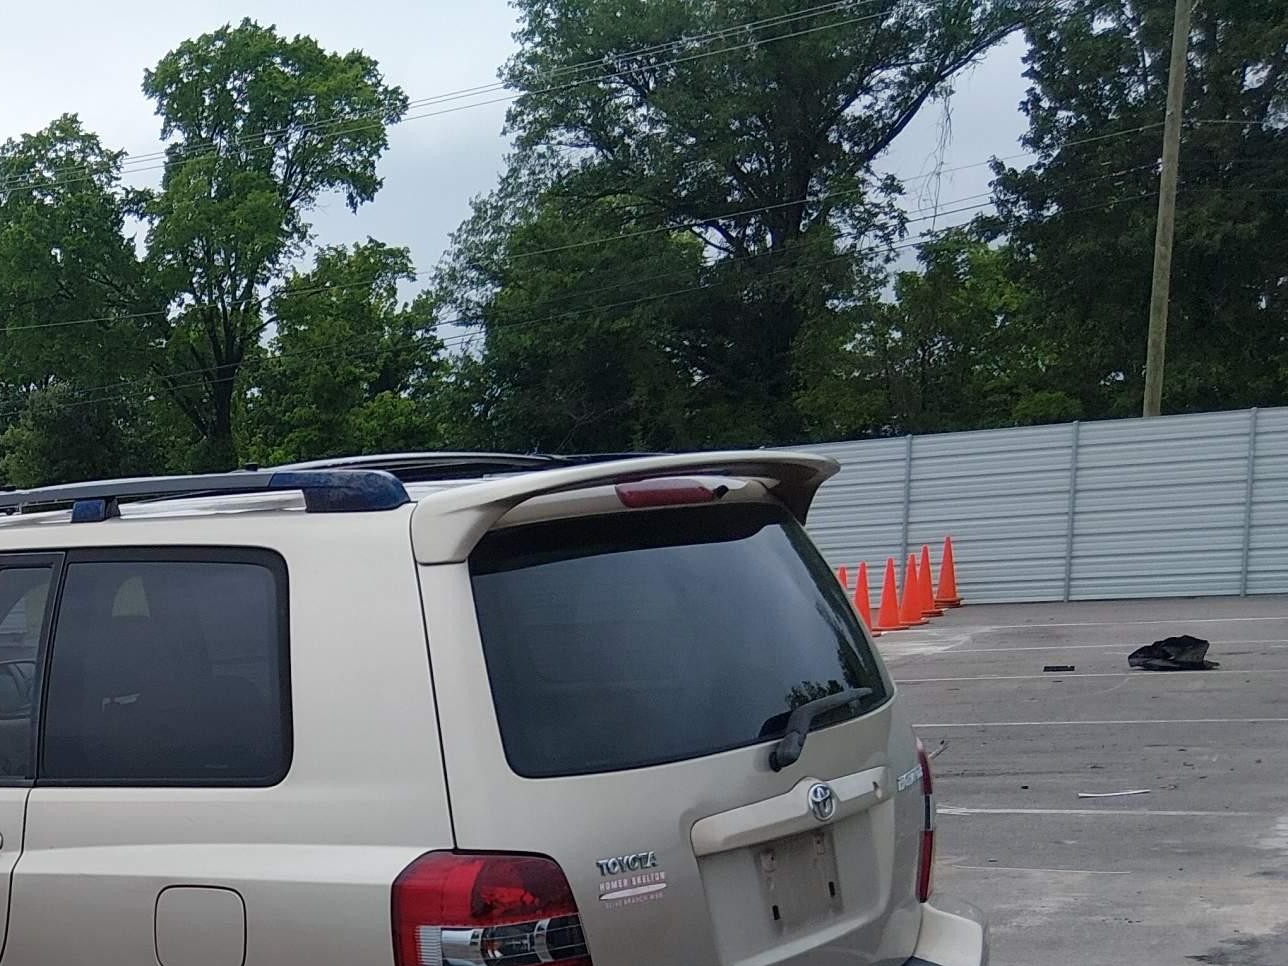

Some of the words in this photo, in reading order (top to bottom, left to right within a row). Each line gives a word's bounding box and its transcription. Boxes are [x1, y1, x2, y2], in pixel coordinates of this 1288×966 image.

[596, 851, 657, 876] TOYOTA
[599, 879, 628, 892] HOMER
[631, 871, 665, 886] SKELTON
